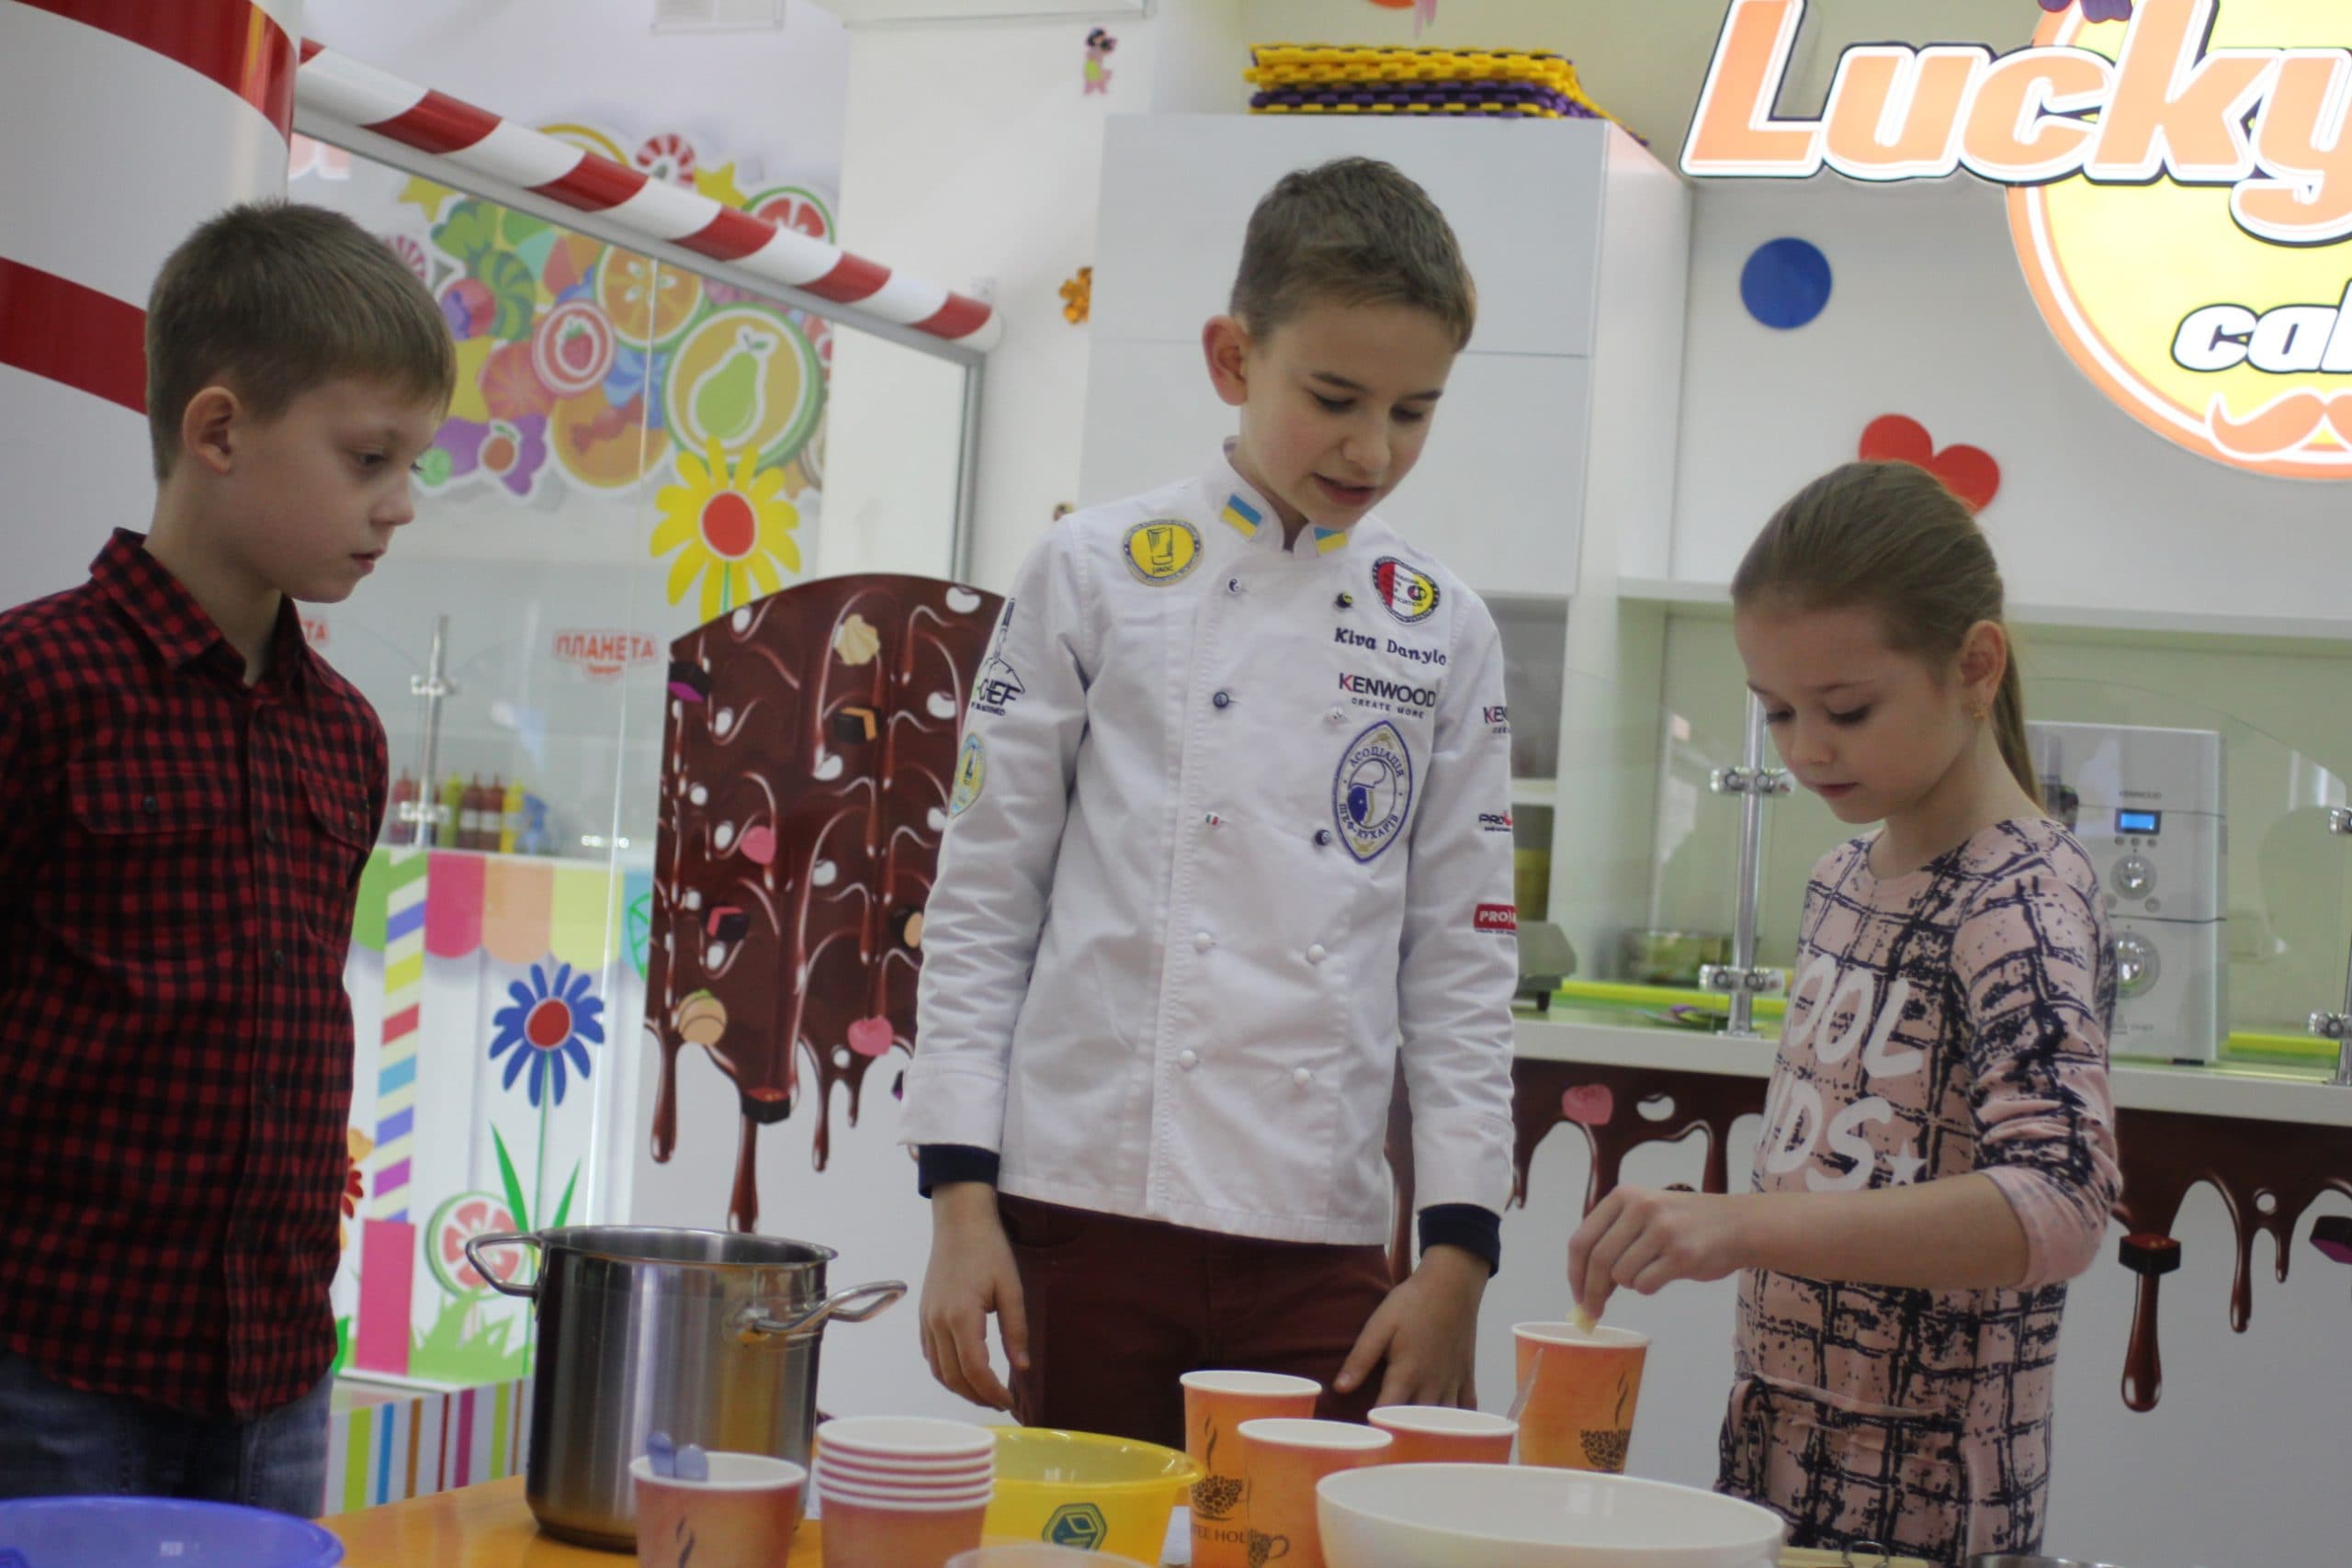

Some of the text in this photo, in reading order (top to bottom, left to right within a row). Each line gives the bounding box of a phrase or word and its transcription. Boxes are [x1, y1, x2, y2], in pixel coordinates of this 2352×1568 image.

[1681, 0, 2352, 246] Lucky
[556, 634, 655, 661] ПЛАНЕТА
[1333, 626, 1447, 666] Kiva Danylo
[1339, 672, 1437, 707] KENWOOD
[1351, 697, 1425, 718] CREATE MORE
